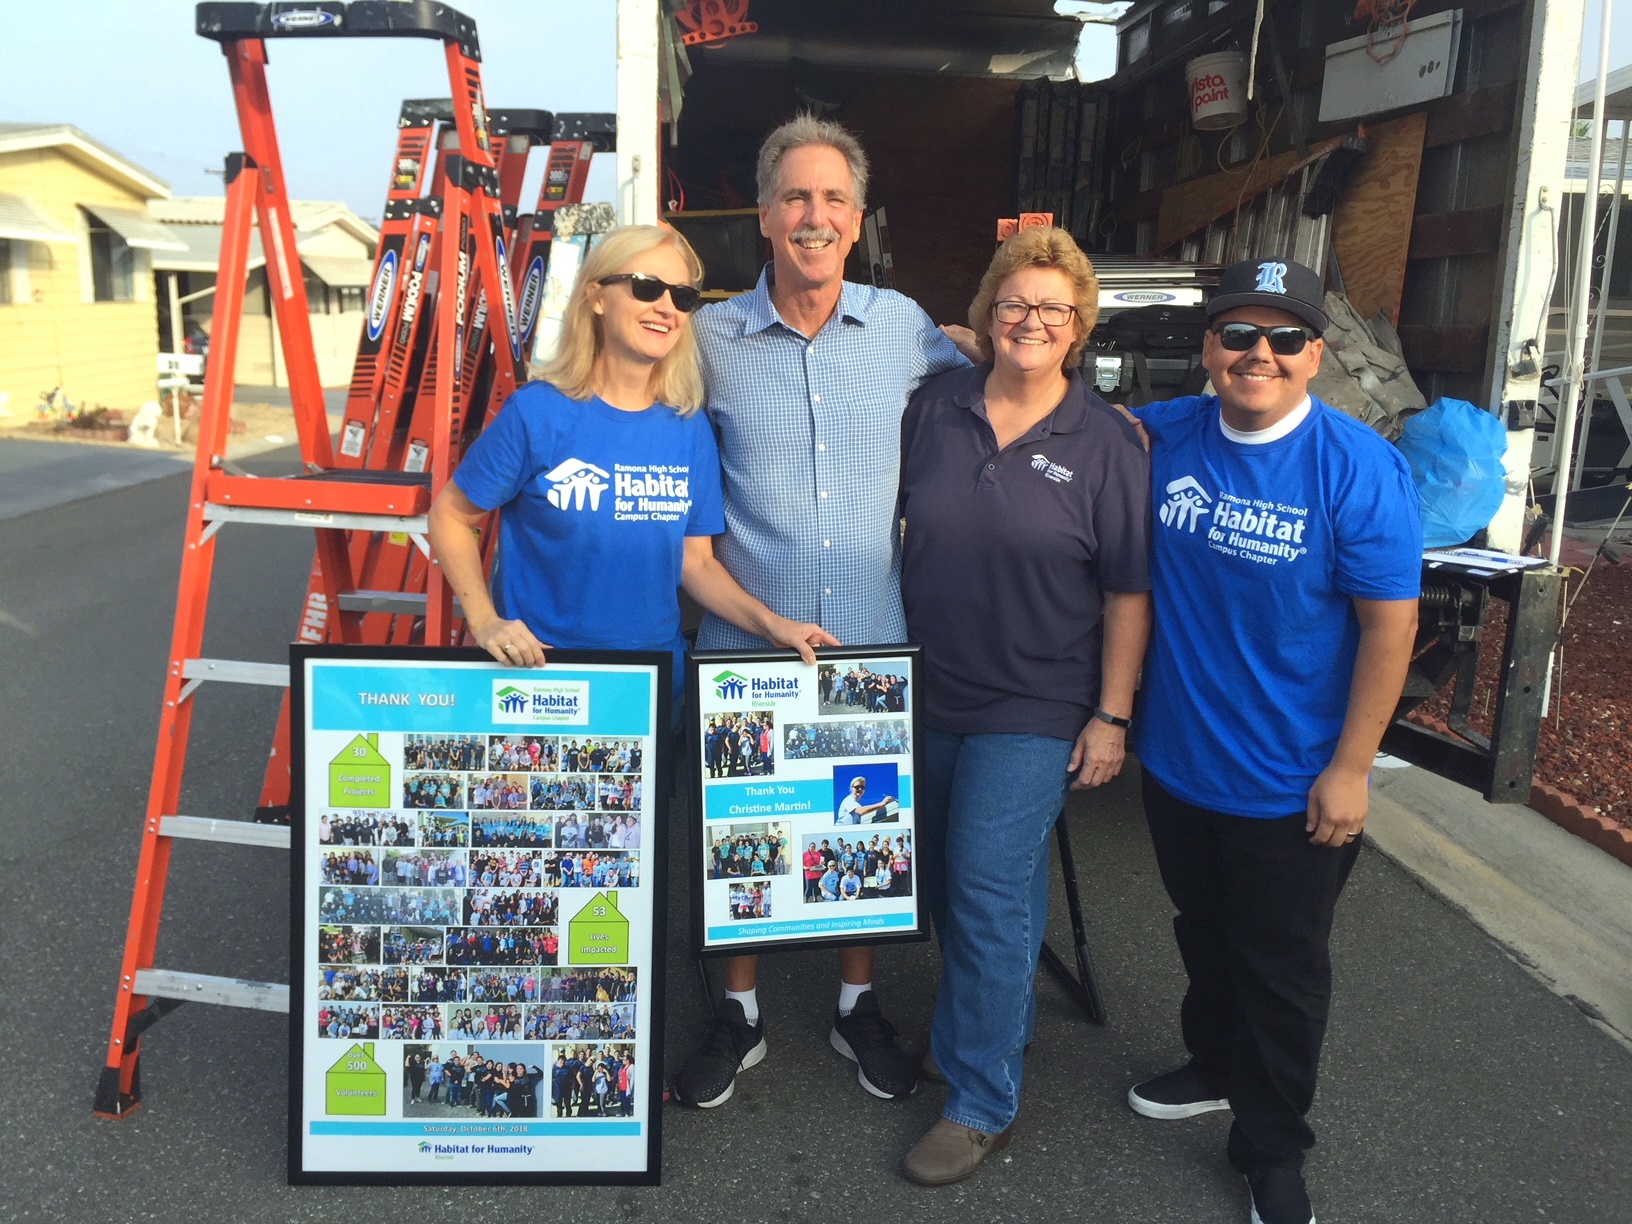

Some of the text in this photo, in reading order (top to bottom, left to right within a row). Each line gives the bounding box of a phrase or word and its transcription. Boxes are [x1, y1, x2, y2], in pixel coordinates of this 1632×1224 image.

[1195, 87, 1229, 113] paint
[1255, 262, 1288, 295] R
[372, 266, 392, 323] WERNER
[456, 251, 467, 325] PODIUM
[402, 270, 423, 322] PODIUM
[520, 273, 540, 327] WERNER
[614, 463, 647, 473] Ramona
[649, 464, 667, 474] High
[1048, 461, 1074, 478] Habitat
[615, 498, 634, 512] for
[1219, 491, 1308, 517] Ramona High School
[614, 512, 680, 522] Campus Chapter
[1213, 501, 1305, 543] Habitat
[1208, 526, 1226, 543] for
[1208, 540, 1278, 566] Campus Chapter
[751, 677, 799, 691] Habitat
[358, 692, 456, 707] THANK YOU!
[532, 694, 578, 707] Habitat
[751, 700, 776, 708] Riverside
[352, 747, 367, 757] 30
[337, 774, 381, 784] Completed
[343, 788, 375, 796] Projects
[745, 785, 795, 796] Thank You
[728, 800, 812, 815] Christine Martin!
[592, 906, 606, 917] 53
[738, 917, 885, 936] Shaping Communities and Inspiring Minds
[589, 933, 609, 941] Lives
[581, 945, 617, 955] Impacted
[347, 1061, 367, 1071] 500
[336, 1088, 378, 1097] Volunteers
[423, 1125, 459, 1133] Saturday,
[460, 1125, 491, 1133] October
[492, 1125, 508, 1133] 6th,
[434, 1144, 469, 1154] Habitat
[471, 1144, 486, 1154] for
